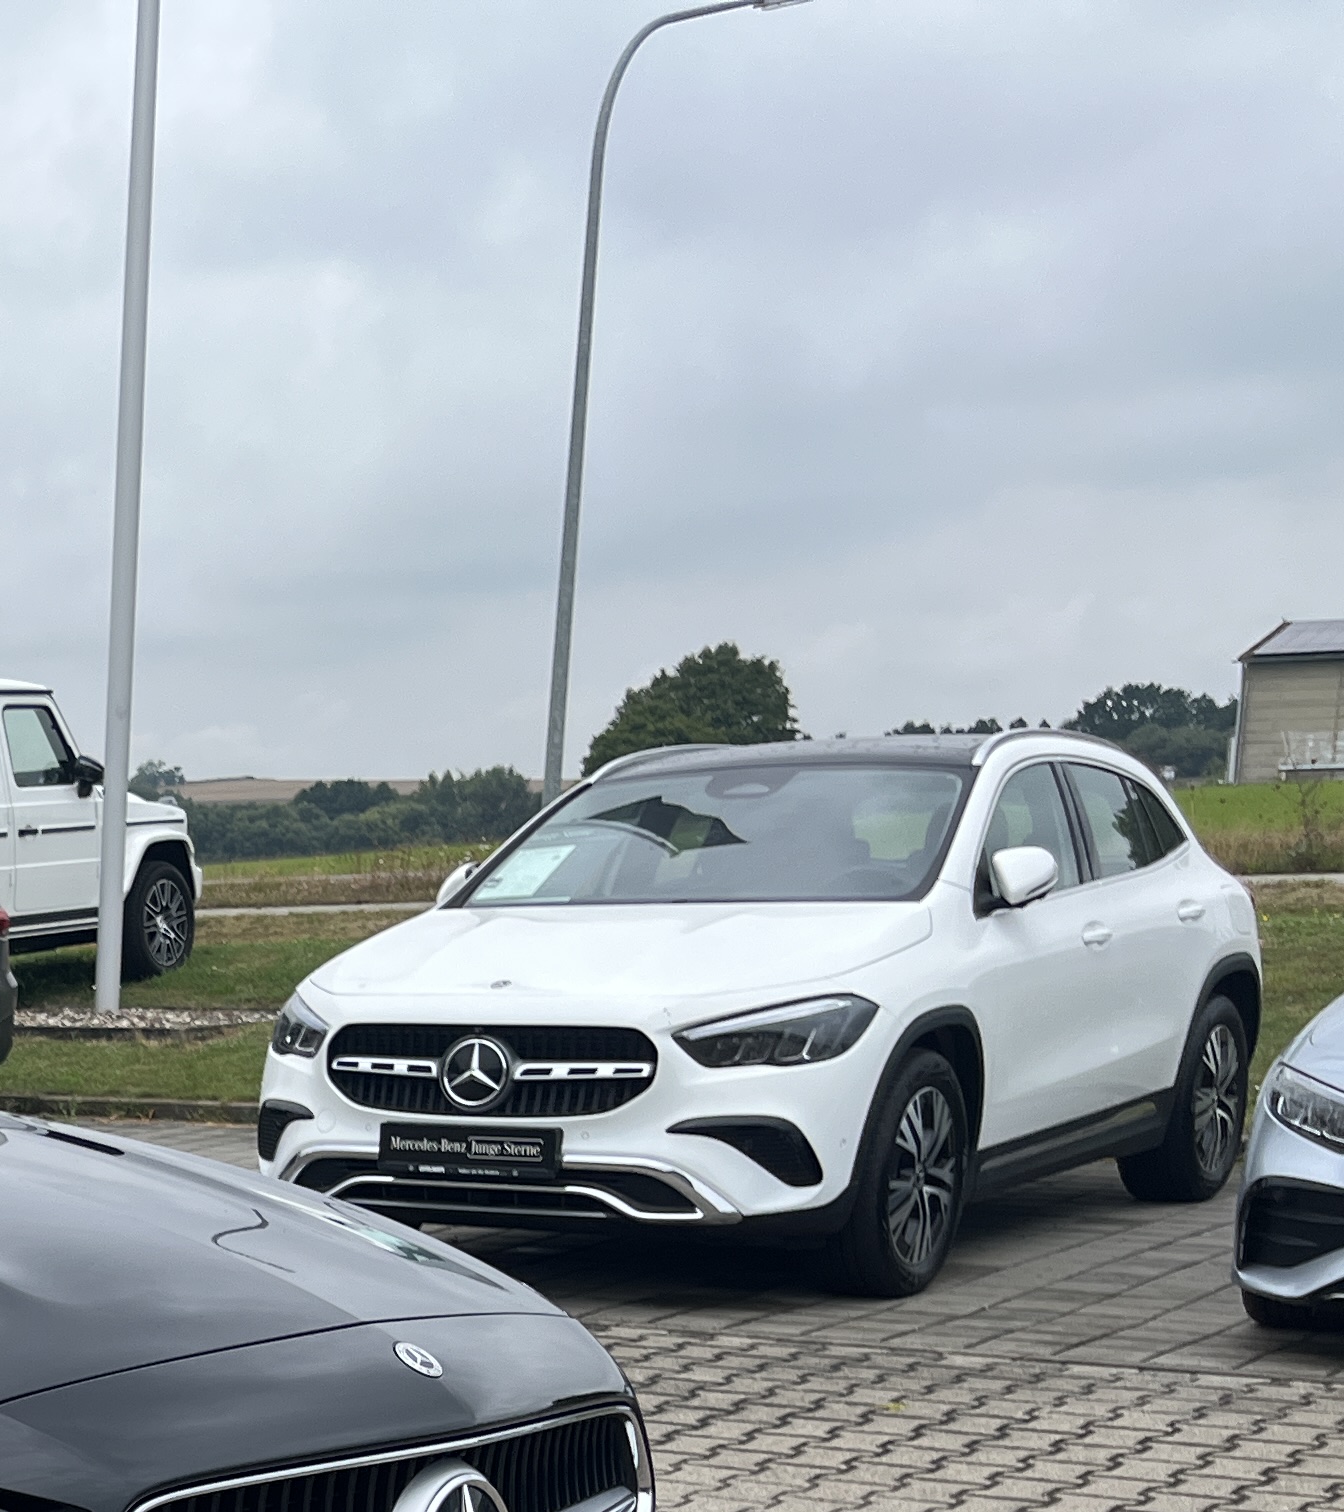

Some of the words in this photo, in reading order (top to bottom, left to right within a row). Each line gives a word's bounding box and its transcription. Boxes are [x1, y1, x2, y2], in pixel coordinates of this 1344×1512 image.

[391, 1136, 466, 1153] Mercedes-Benz
[471, 1140, 502, 1157] Junge
[503, 1142, 541, 1157] Sterne
